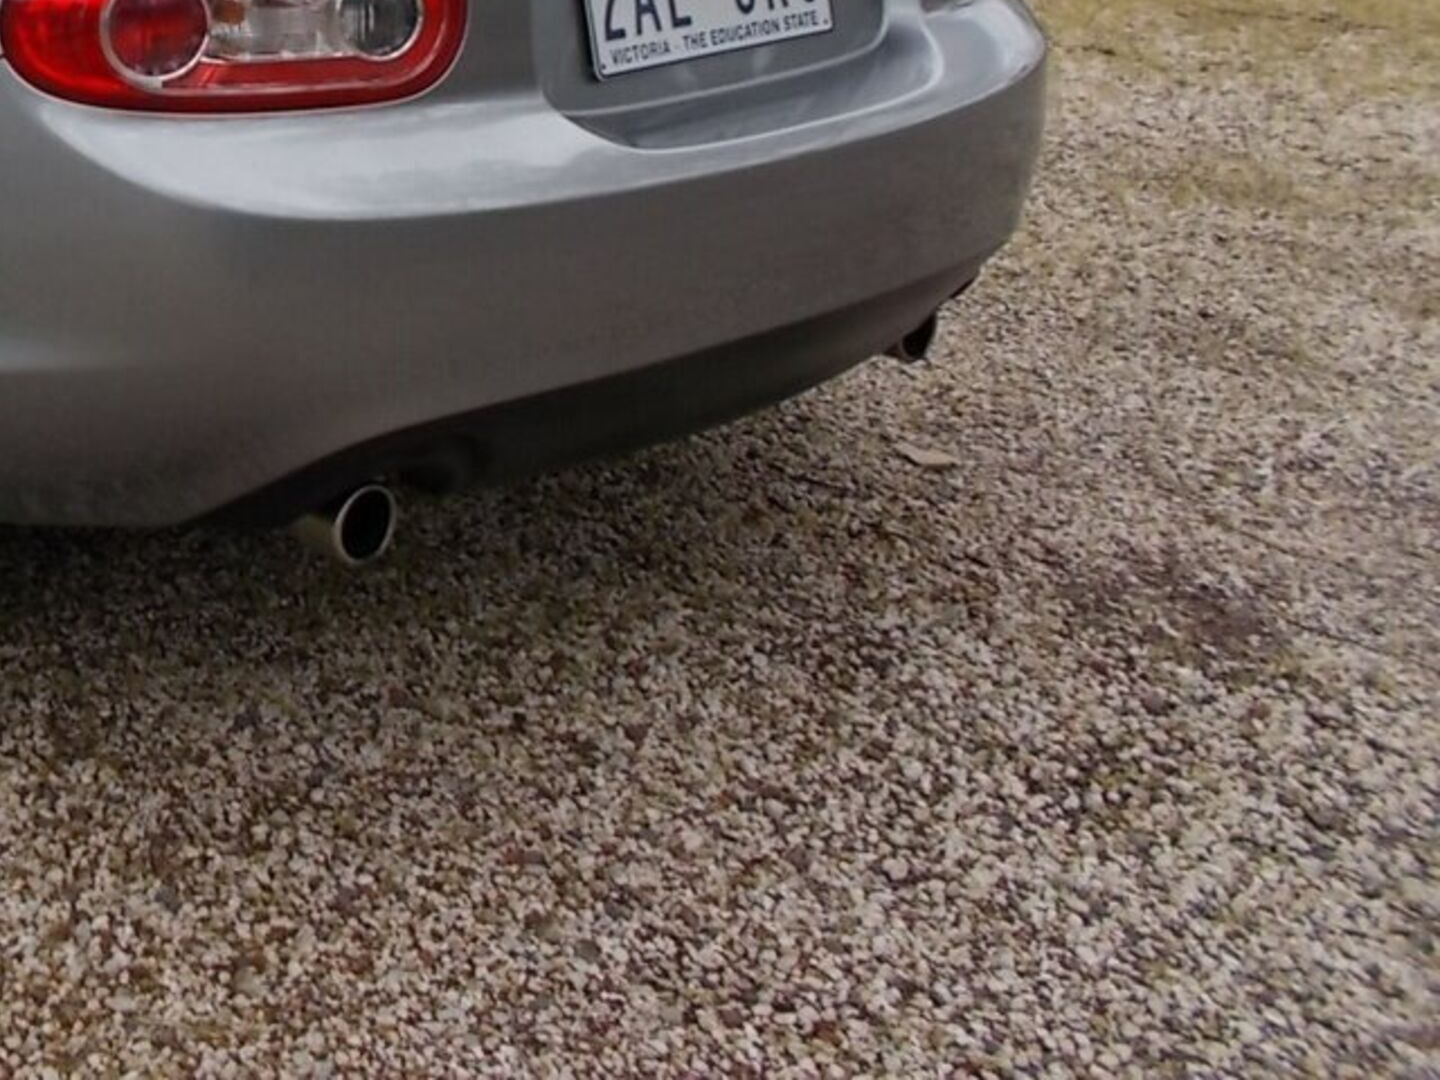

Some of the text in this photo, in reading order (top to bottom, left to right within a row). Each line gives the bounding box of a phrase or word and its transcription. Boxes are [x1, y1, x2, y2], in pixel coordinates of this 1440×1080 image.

[610, 10, 819, 65] VICTORIA THE EDUCATION STATE
